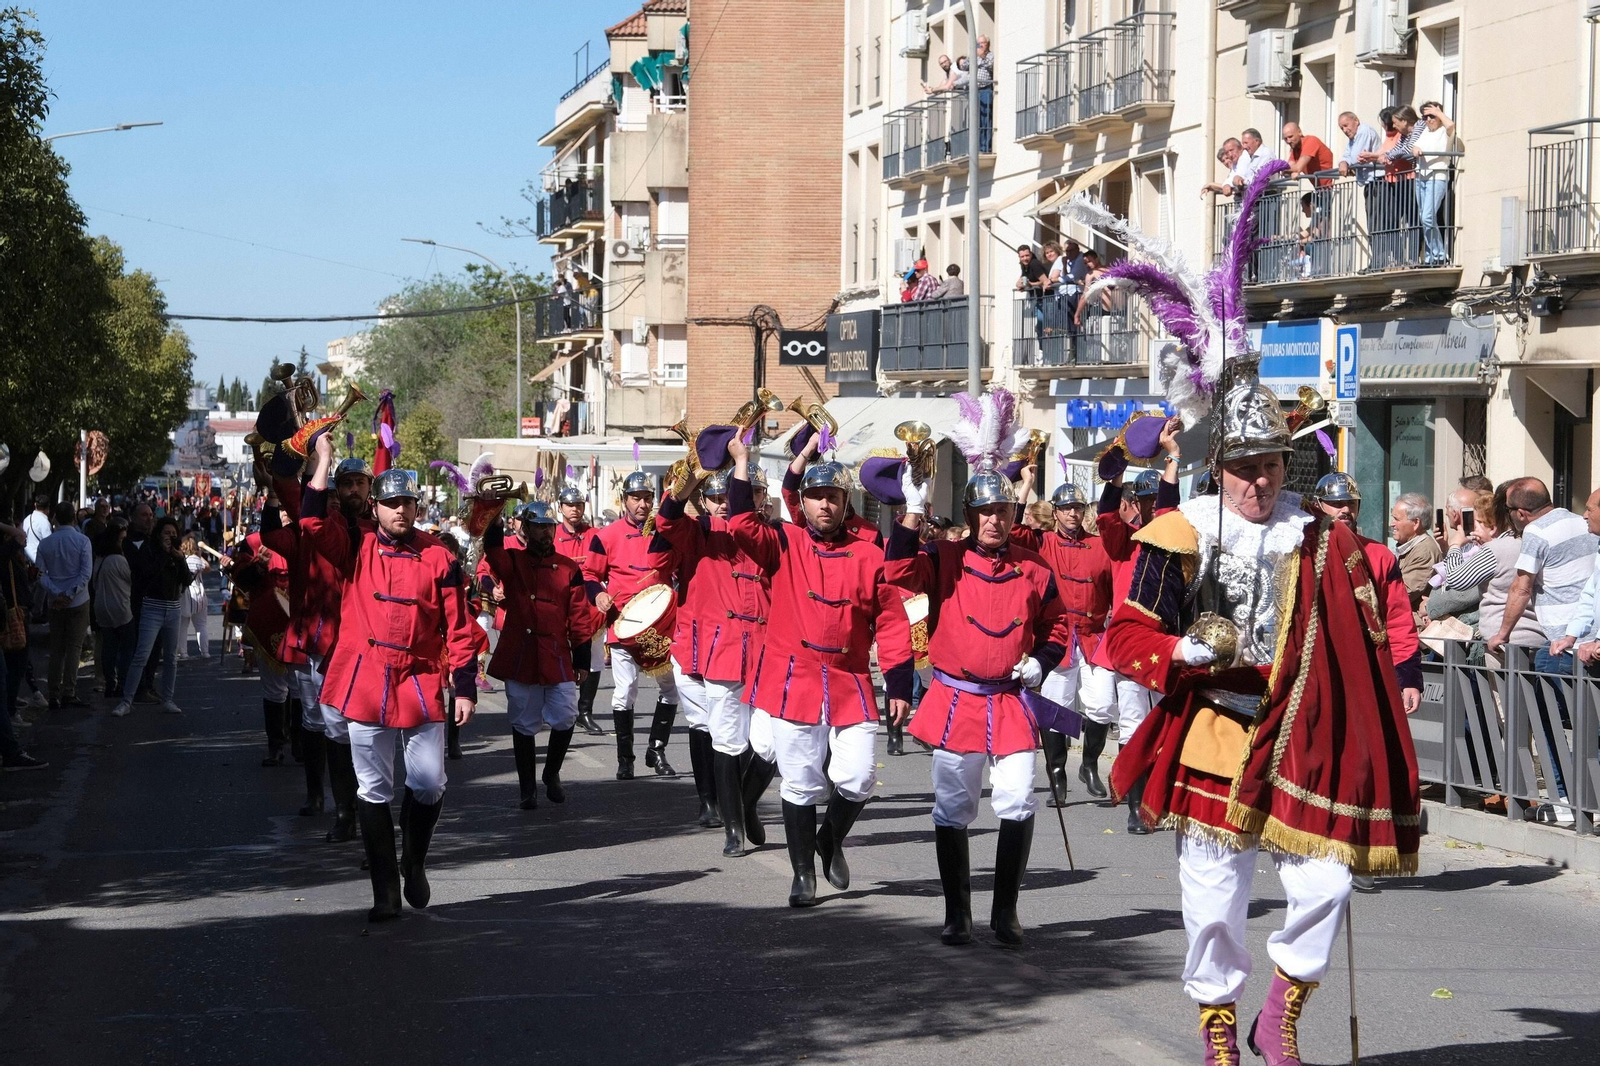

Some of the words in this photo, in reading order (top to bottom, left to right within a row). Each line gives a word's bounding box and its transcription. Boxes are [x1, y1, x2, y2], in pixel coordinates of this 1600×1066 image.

[1262, 343, 1285, 357] PINTURAS
[1286, 341, 1320, 357] MONTICOLOR
[1340, 333, 1355, 394] P
